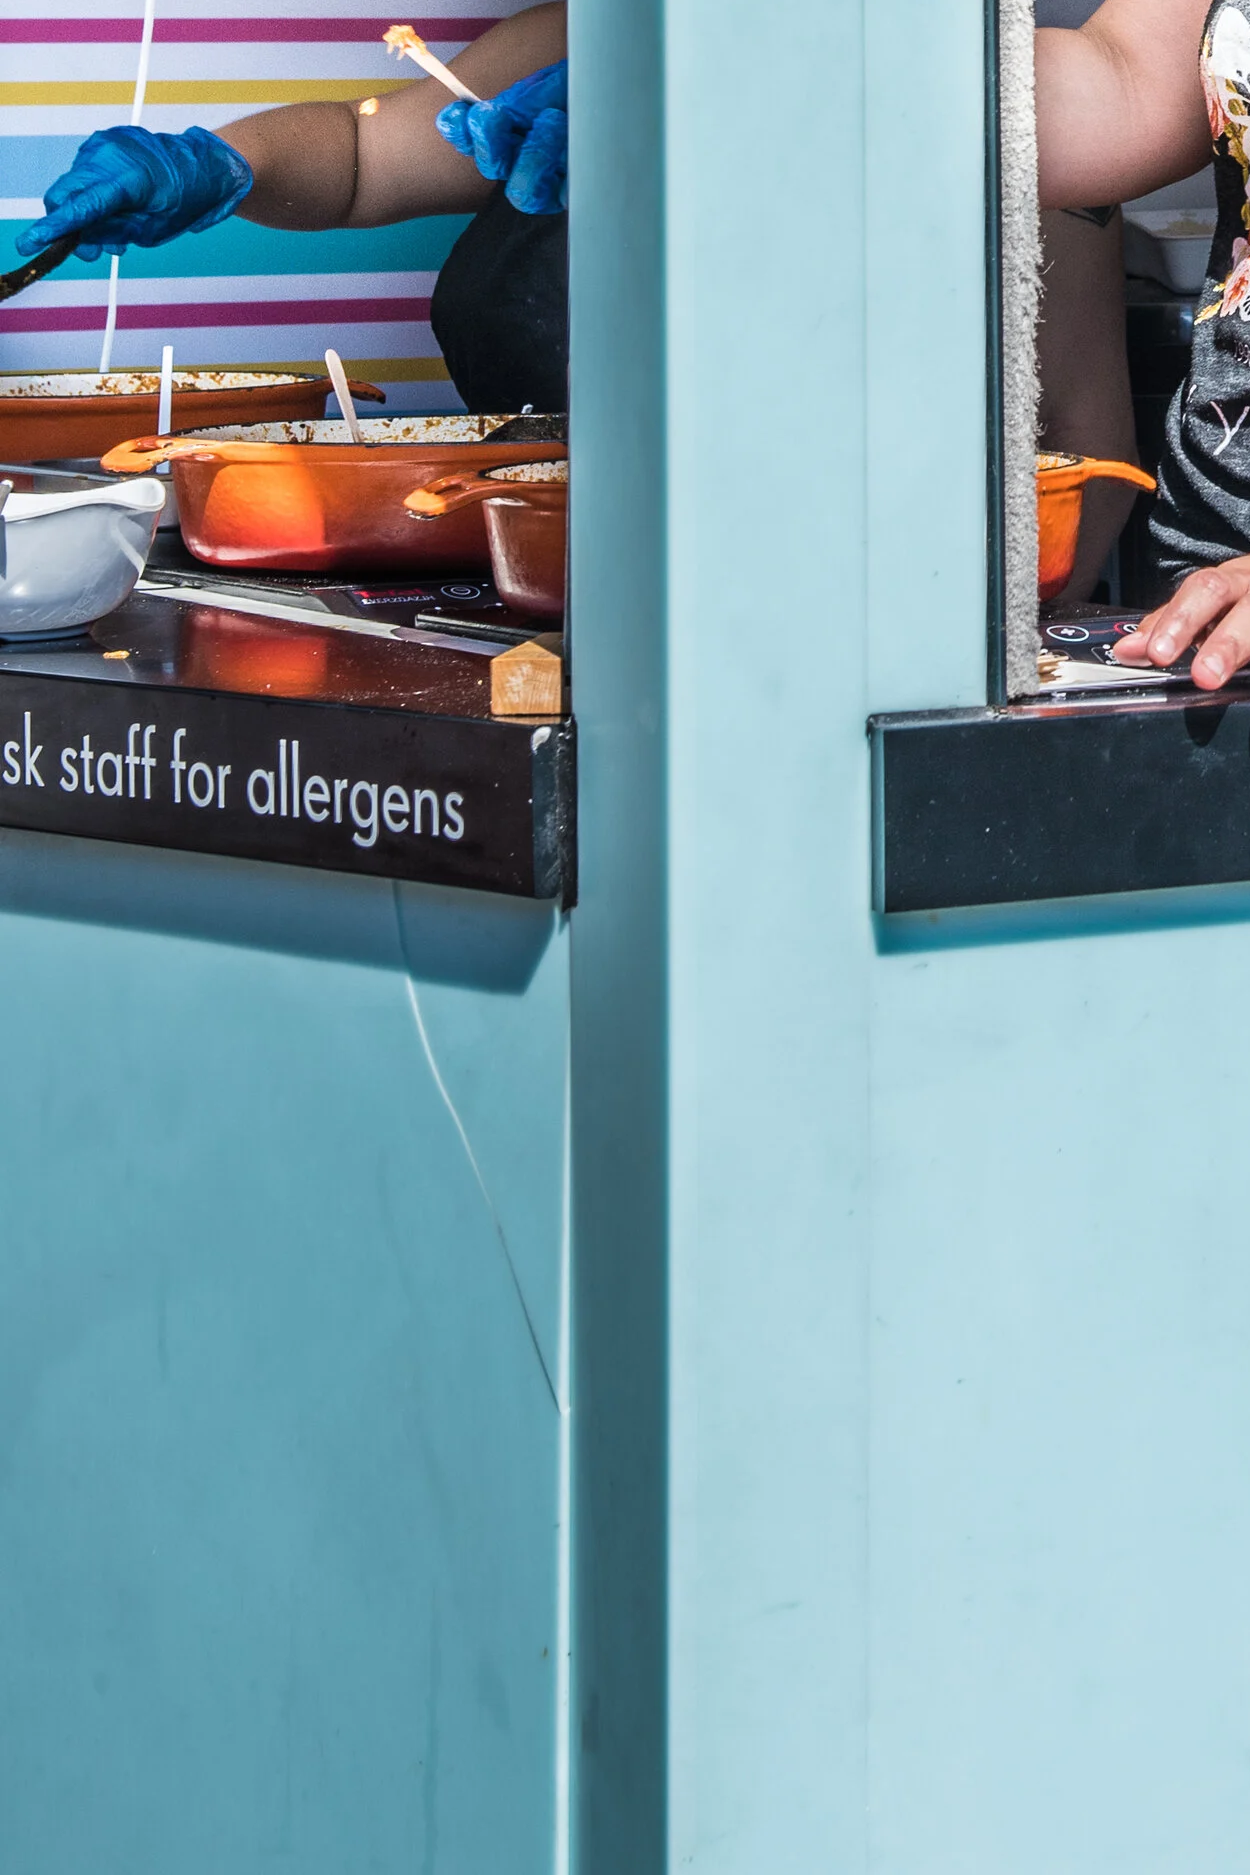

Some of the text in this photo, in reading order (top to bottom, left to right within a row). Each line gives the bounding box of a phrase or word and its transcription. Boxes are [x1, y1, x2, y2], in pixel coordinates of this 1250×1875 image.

[2, 711, 465, 848] sk staff for allergens
